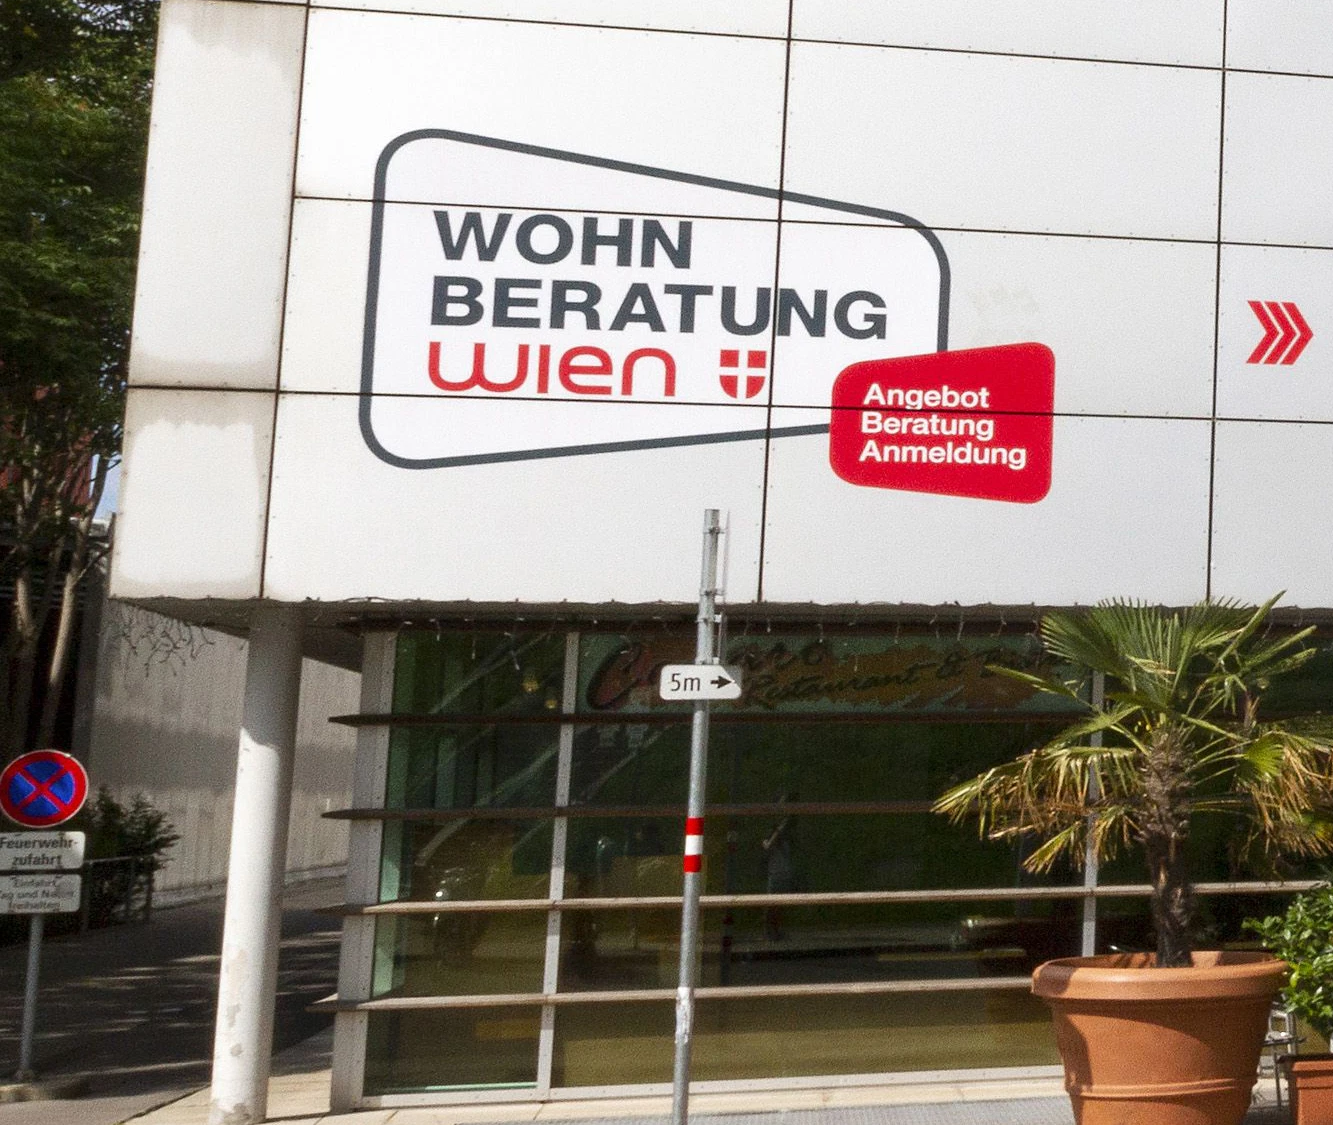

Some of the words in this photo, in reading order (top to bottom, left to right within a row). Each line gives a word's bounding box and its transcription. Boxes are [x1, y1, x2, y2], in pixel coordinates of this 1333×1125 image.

[433, 210, 694, 270] WOHN
[429, 275, 889, 341] BERATUNG
[862, 382, 991, 410] Angebot
[860, 412, 996, 442] Beratung
[858, 442, 1028, 470] Anmeldung
[669, 672, 702, 693] 5m
[12, 854, 62, 865] zufahrt
